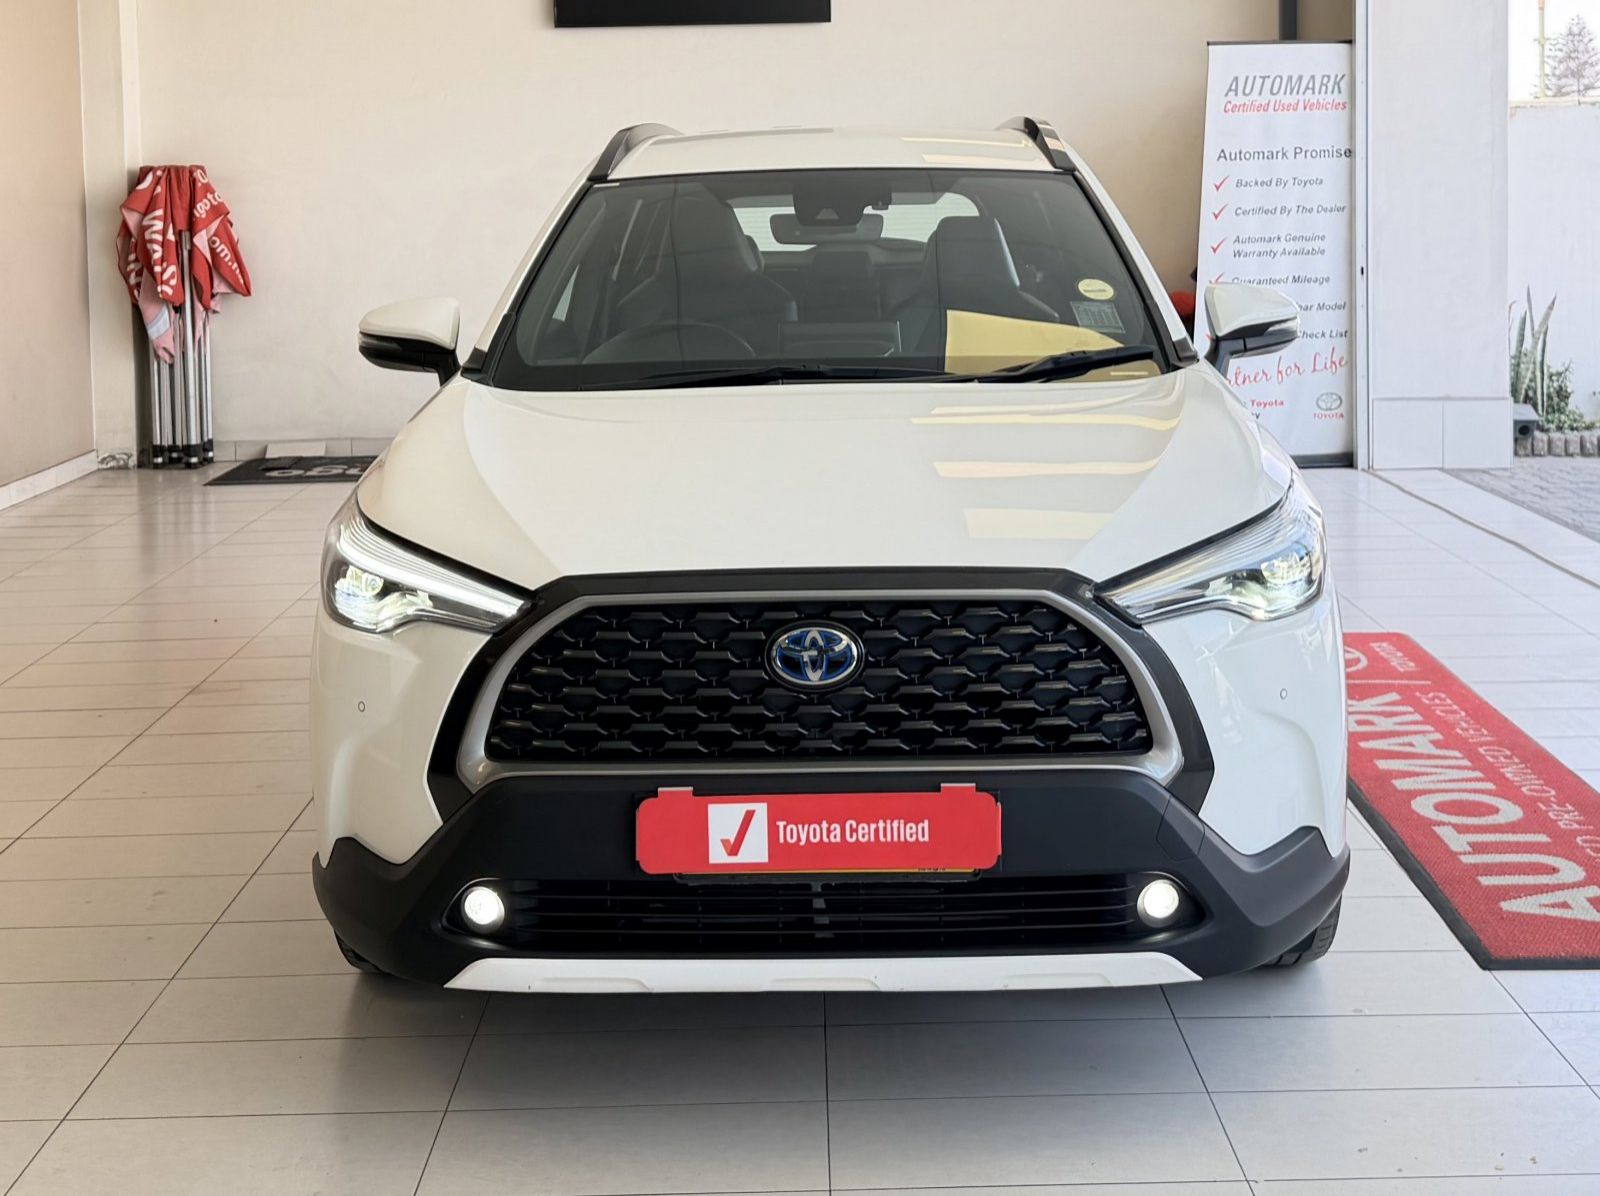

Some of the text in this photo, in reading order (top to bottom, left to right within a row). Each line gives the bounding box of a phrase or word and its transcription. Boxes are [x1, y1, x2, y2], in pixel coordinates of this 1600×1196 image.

[1224, 73, 1346, 97] AUTOMARK
[1223, 98, 1348, 114] Certified Used Vehicles
[1216, 145, 1352, 161] Automark Promise
[1235, 177, 1323, 189] Backed By Toyota
[1234, 204, 1346, 216] Certified By The Dealer
[1233, 232, 1326, 244] Automark Genuine
[1233, 247, 1325, 259] Warranty Available
[1291, 275, 1330, 286] Mileage
[1316, 301, 1346, 311] Model
[1299, 329, 1348, 339] heck List
[1277, 355, 1306, 385] for
[1311, 345, 1348, 375] Life
[1250, 399, 1284, 409] Toyota
[1313, 411, 1344, 420] TOYOTA
[1415, 690, 1594, 832] PRE-OWNED VEHICLES
[1347, 692, 1600, 922] AUTOMARK
[776, 819, 929, 846] Toyota Certified
